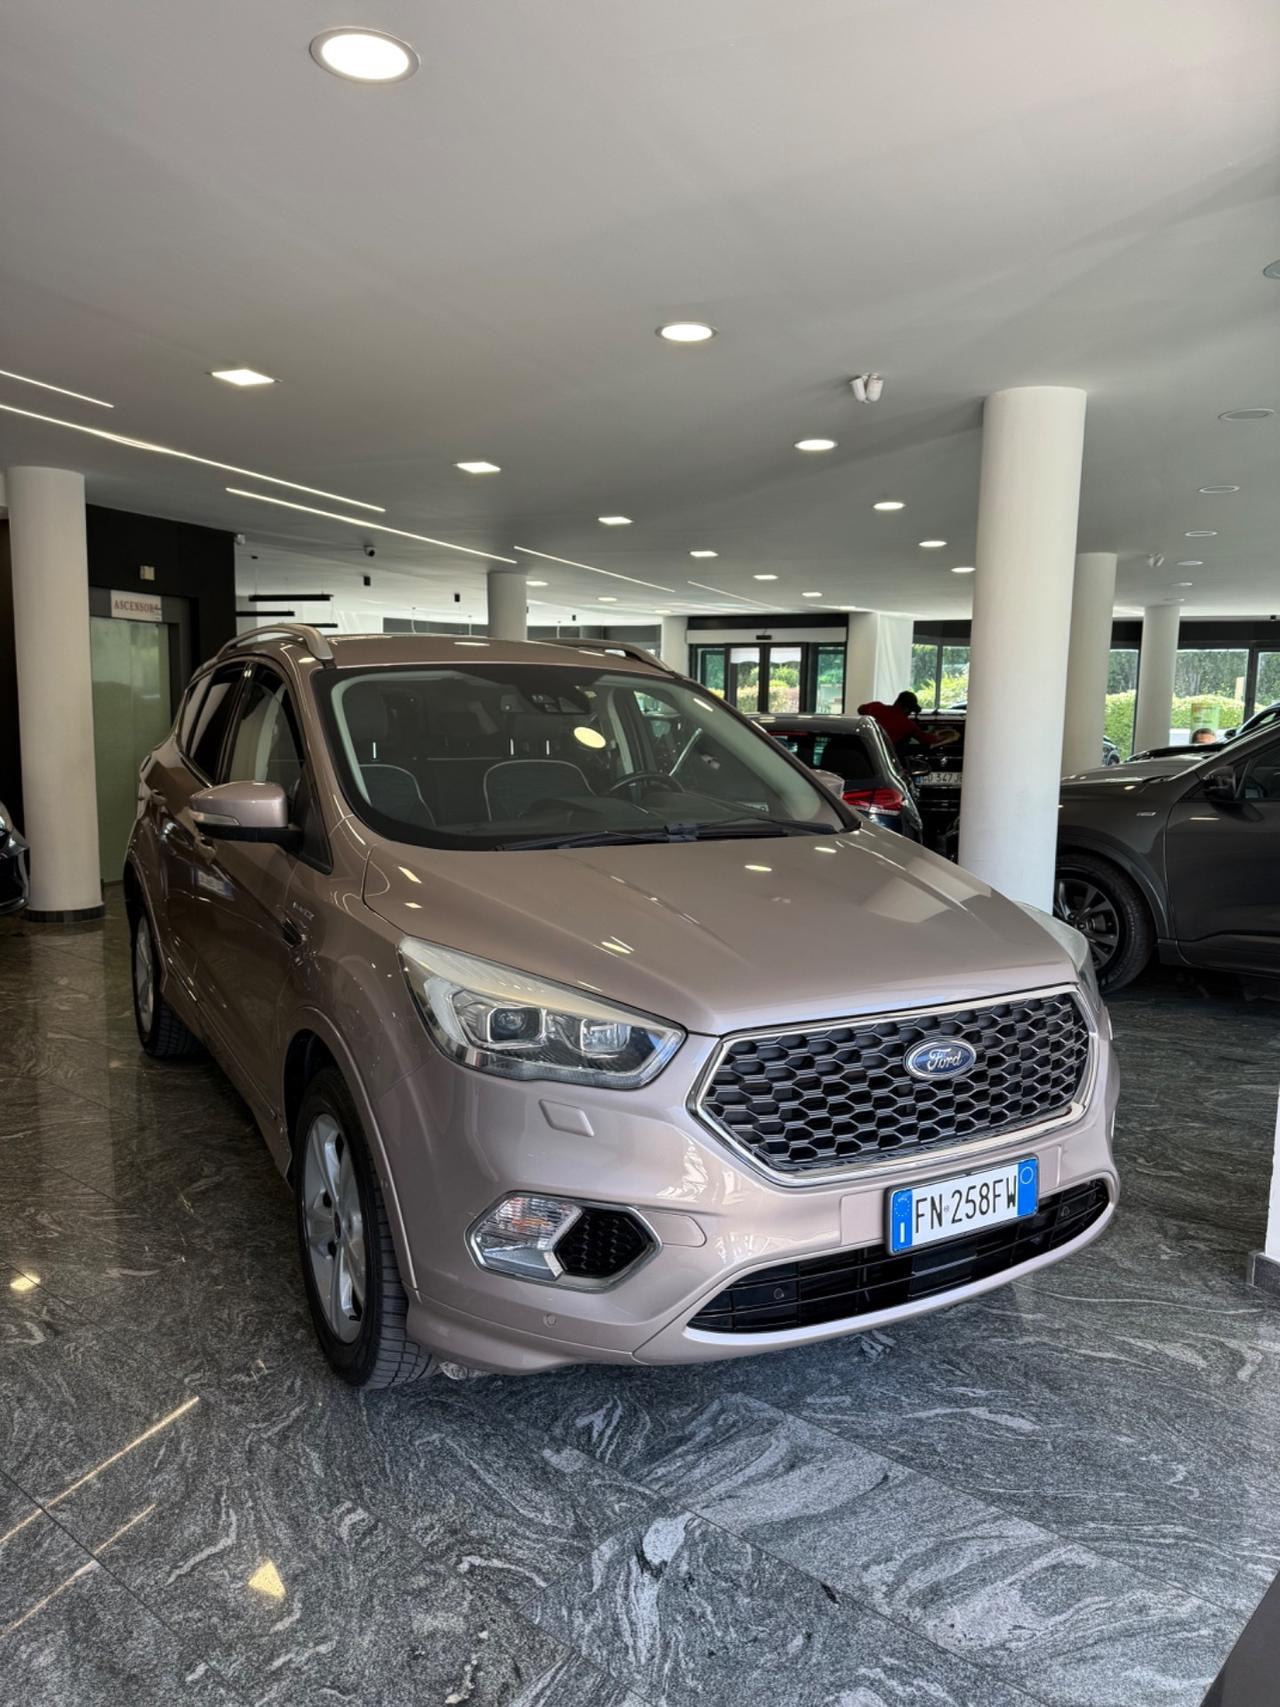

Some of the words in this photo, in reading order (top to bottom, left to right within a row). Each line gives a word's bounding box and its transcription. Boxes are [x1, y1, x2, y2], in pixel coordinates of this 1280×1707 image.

[927, 1048, 962, 1071] Ford
[915, 1194, 943, 1233] FN
[951, 1175, 1017, 1224] 258FW
